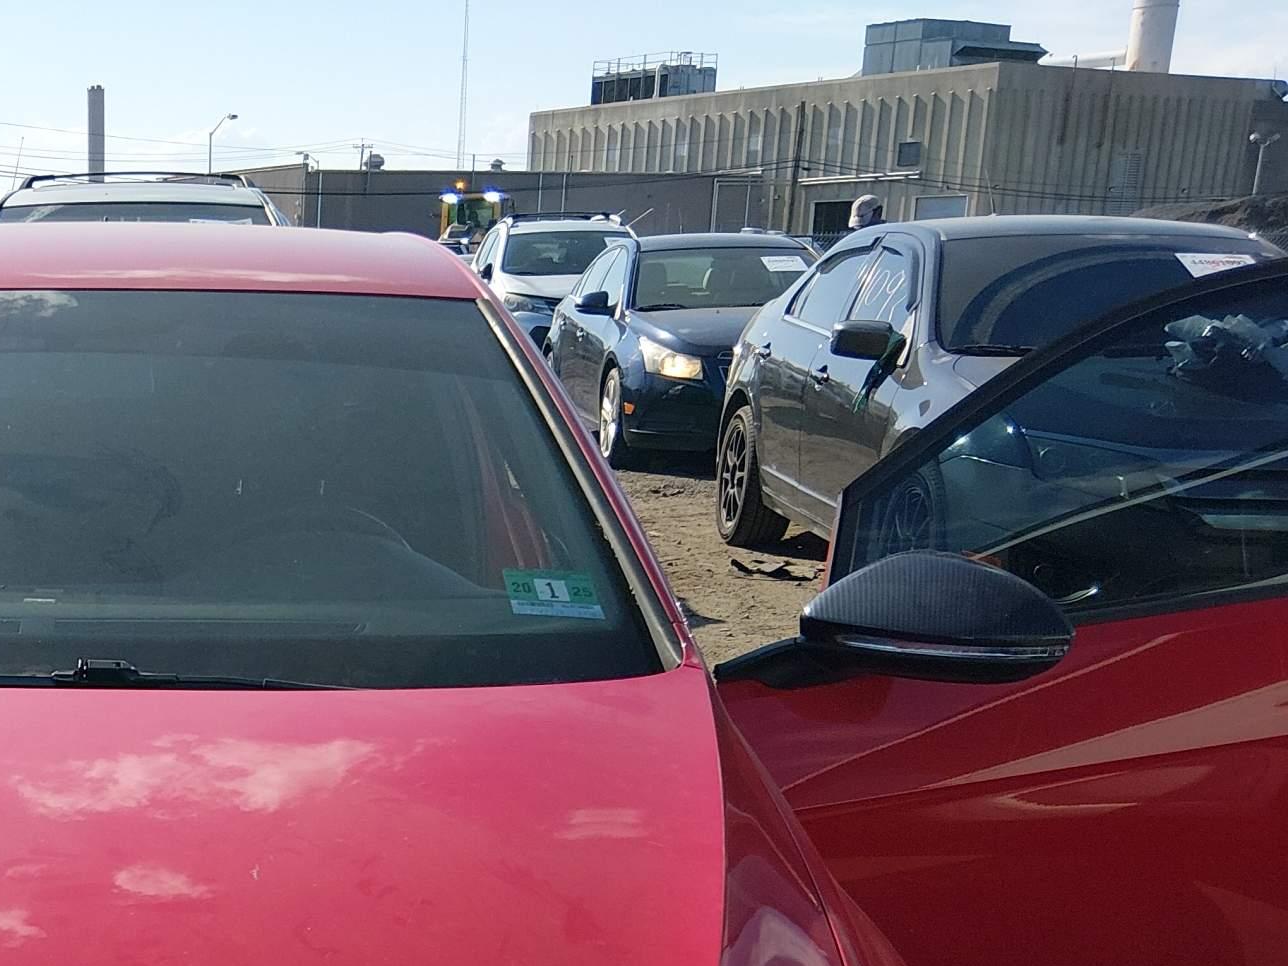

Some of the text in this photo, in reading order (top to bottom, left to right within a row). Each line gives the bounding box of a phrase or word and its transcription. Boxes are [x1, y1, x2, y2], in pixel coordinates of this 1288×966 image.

[512, 582, 593, 599] 20 1 25
